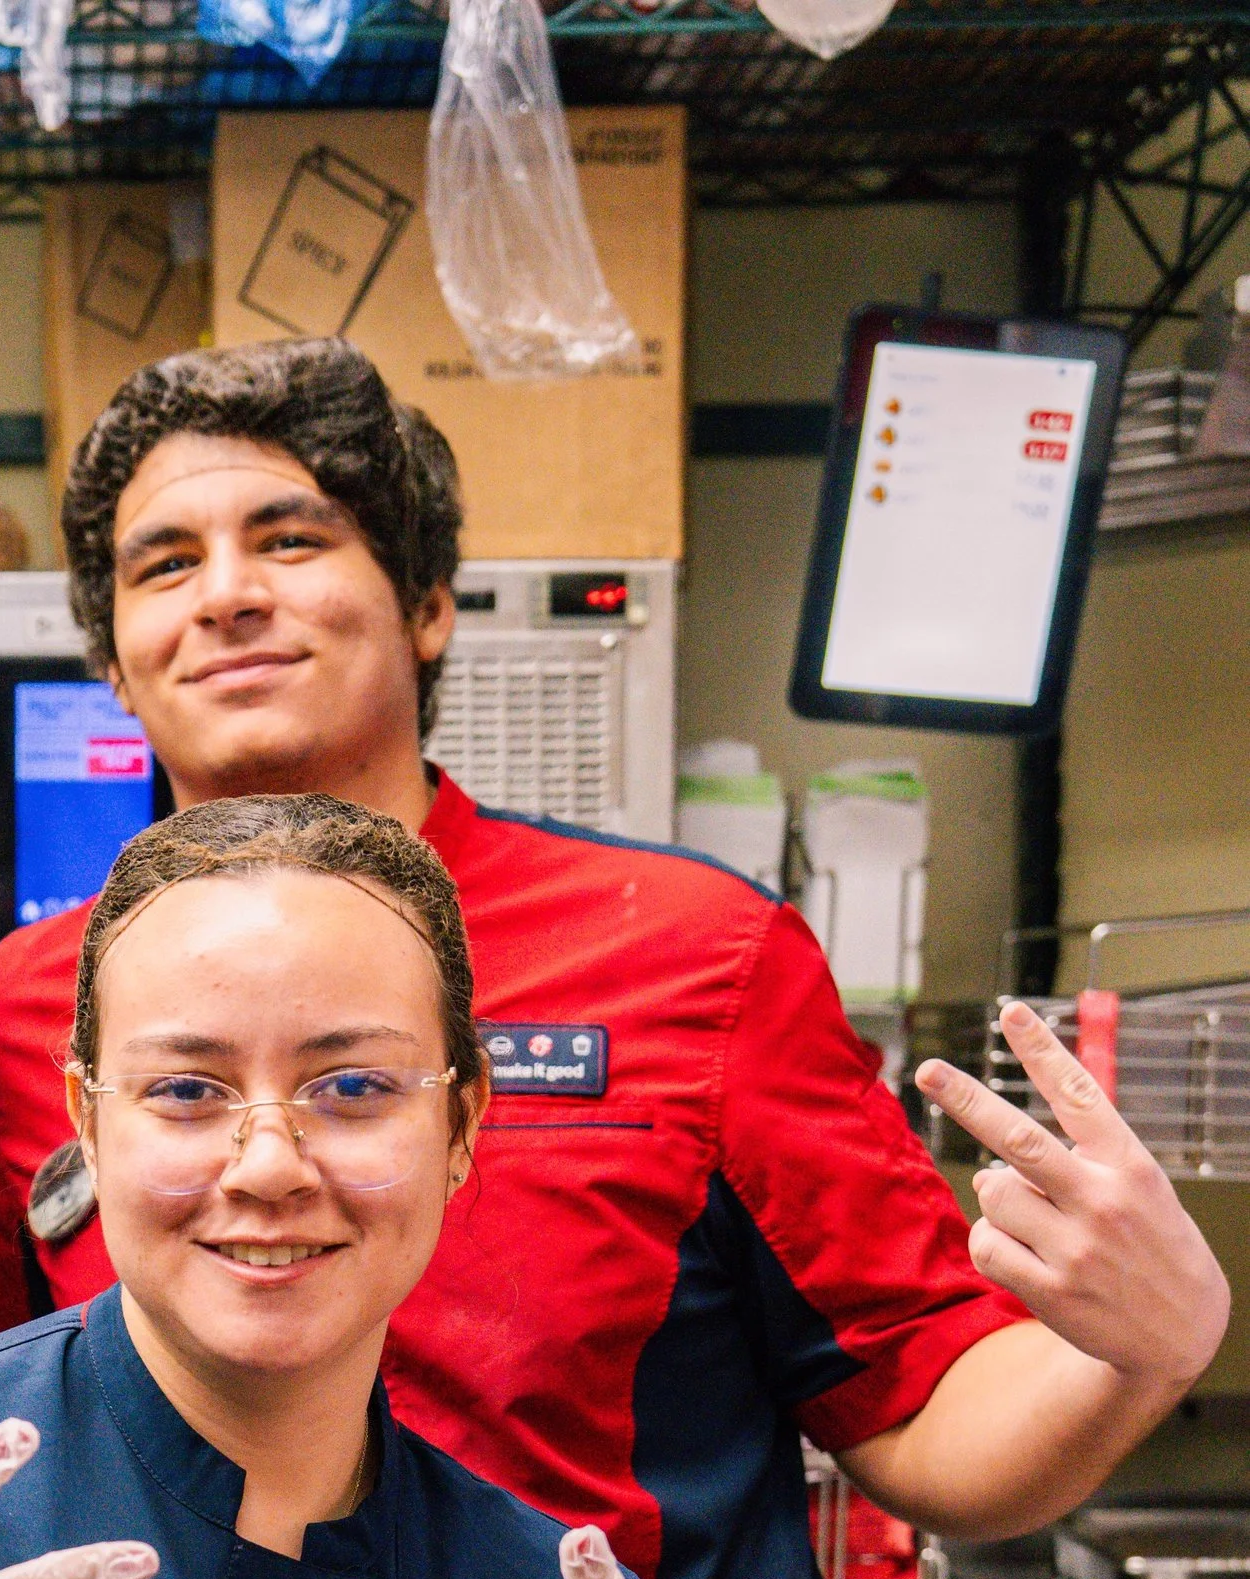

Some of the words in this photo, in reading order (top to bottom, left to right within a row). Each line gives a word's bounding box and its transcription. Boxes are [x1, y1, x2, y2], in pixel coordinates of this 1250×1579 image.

[492, 1061, 533, 1079] make
[533, 1061, 545, 1079] it
[546, 1061, 585, 1082] good
